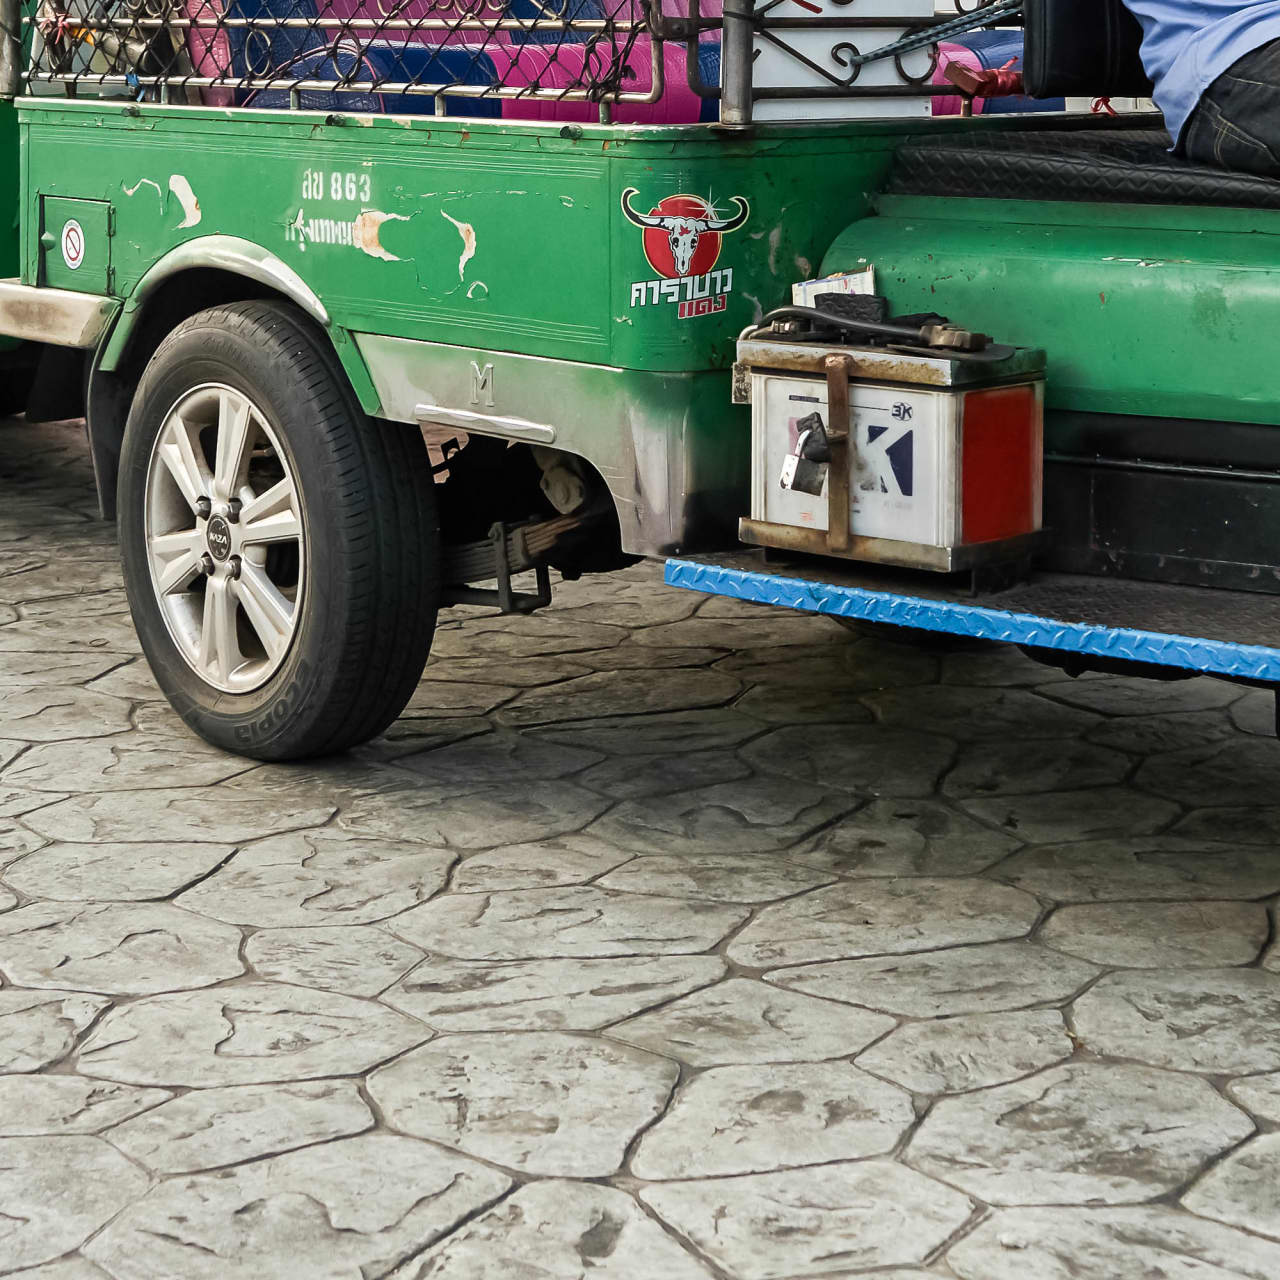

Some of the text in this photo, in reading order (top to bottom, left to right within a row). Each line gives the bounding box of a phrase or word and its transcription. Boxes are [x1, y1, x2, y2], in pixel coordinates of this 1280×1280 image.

[330, 172, 371, 202] 863
[630, 268, 733, 308] คาราบาว
[678, 294, 727, 319] แดง
[891, 402, 913, 421] 3K
